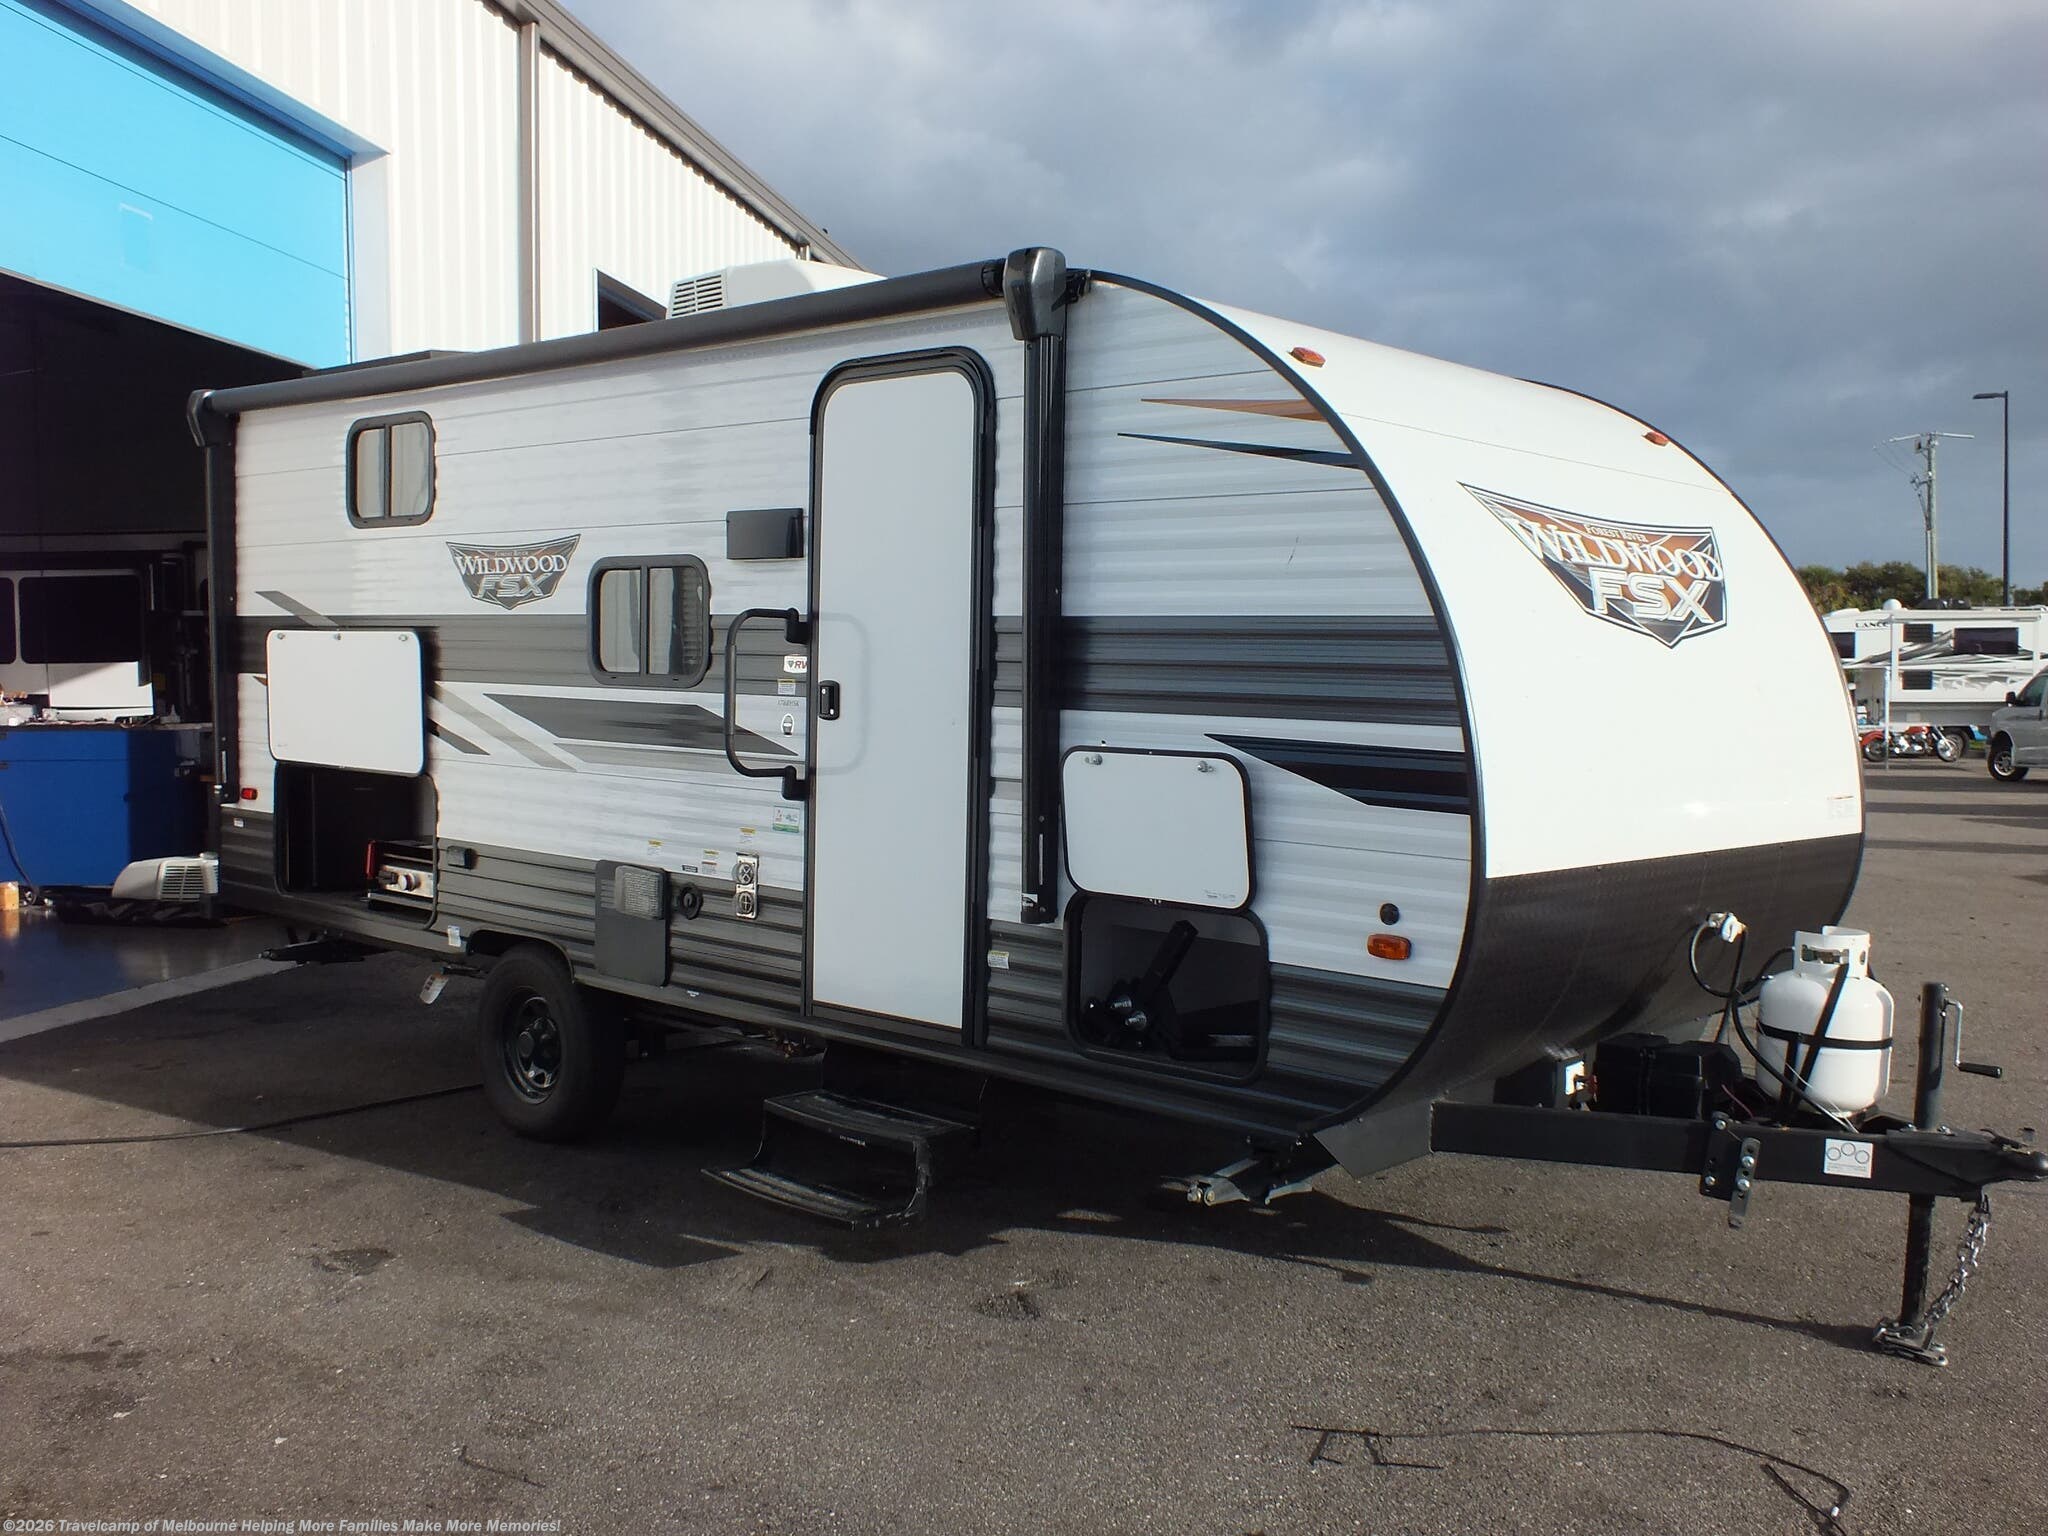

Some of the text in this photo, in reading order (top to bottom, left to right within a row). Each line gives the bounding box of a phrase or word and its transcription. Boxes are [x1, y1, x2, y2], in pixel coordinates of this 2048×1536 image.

[1584, 523, 1621, 538] FOREST
[1502, 516, 1725, 582] WILDWOOD
[454, 554, 568, 575] WILDWOOD
[476, 572, 553, 598] FSX
[1588, 566, 1716, 624] FSX
